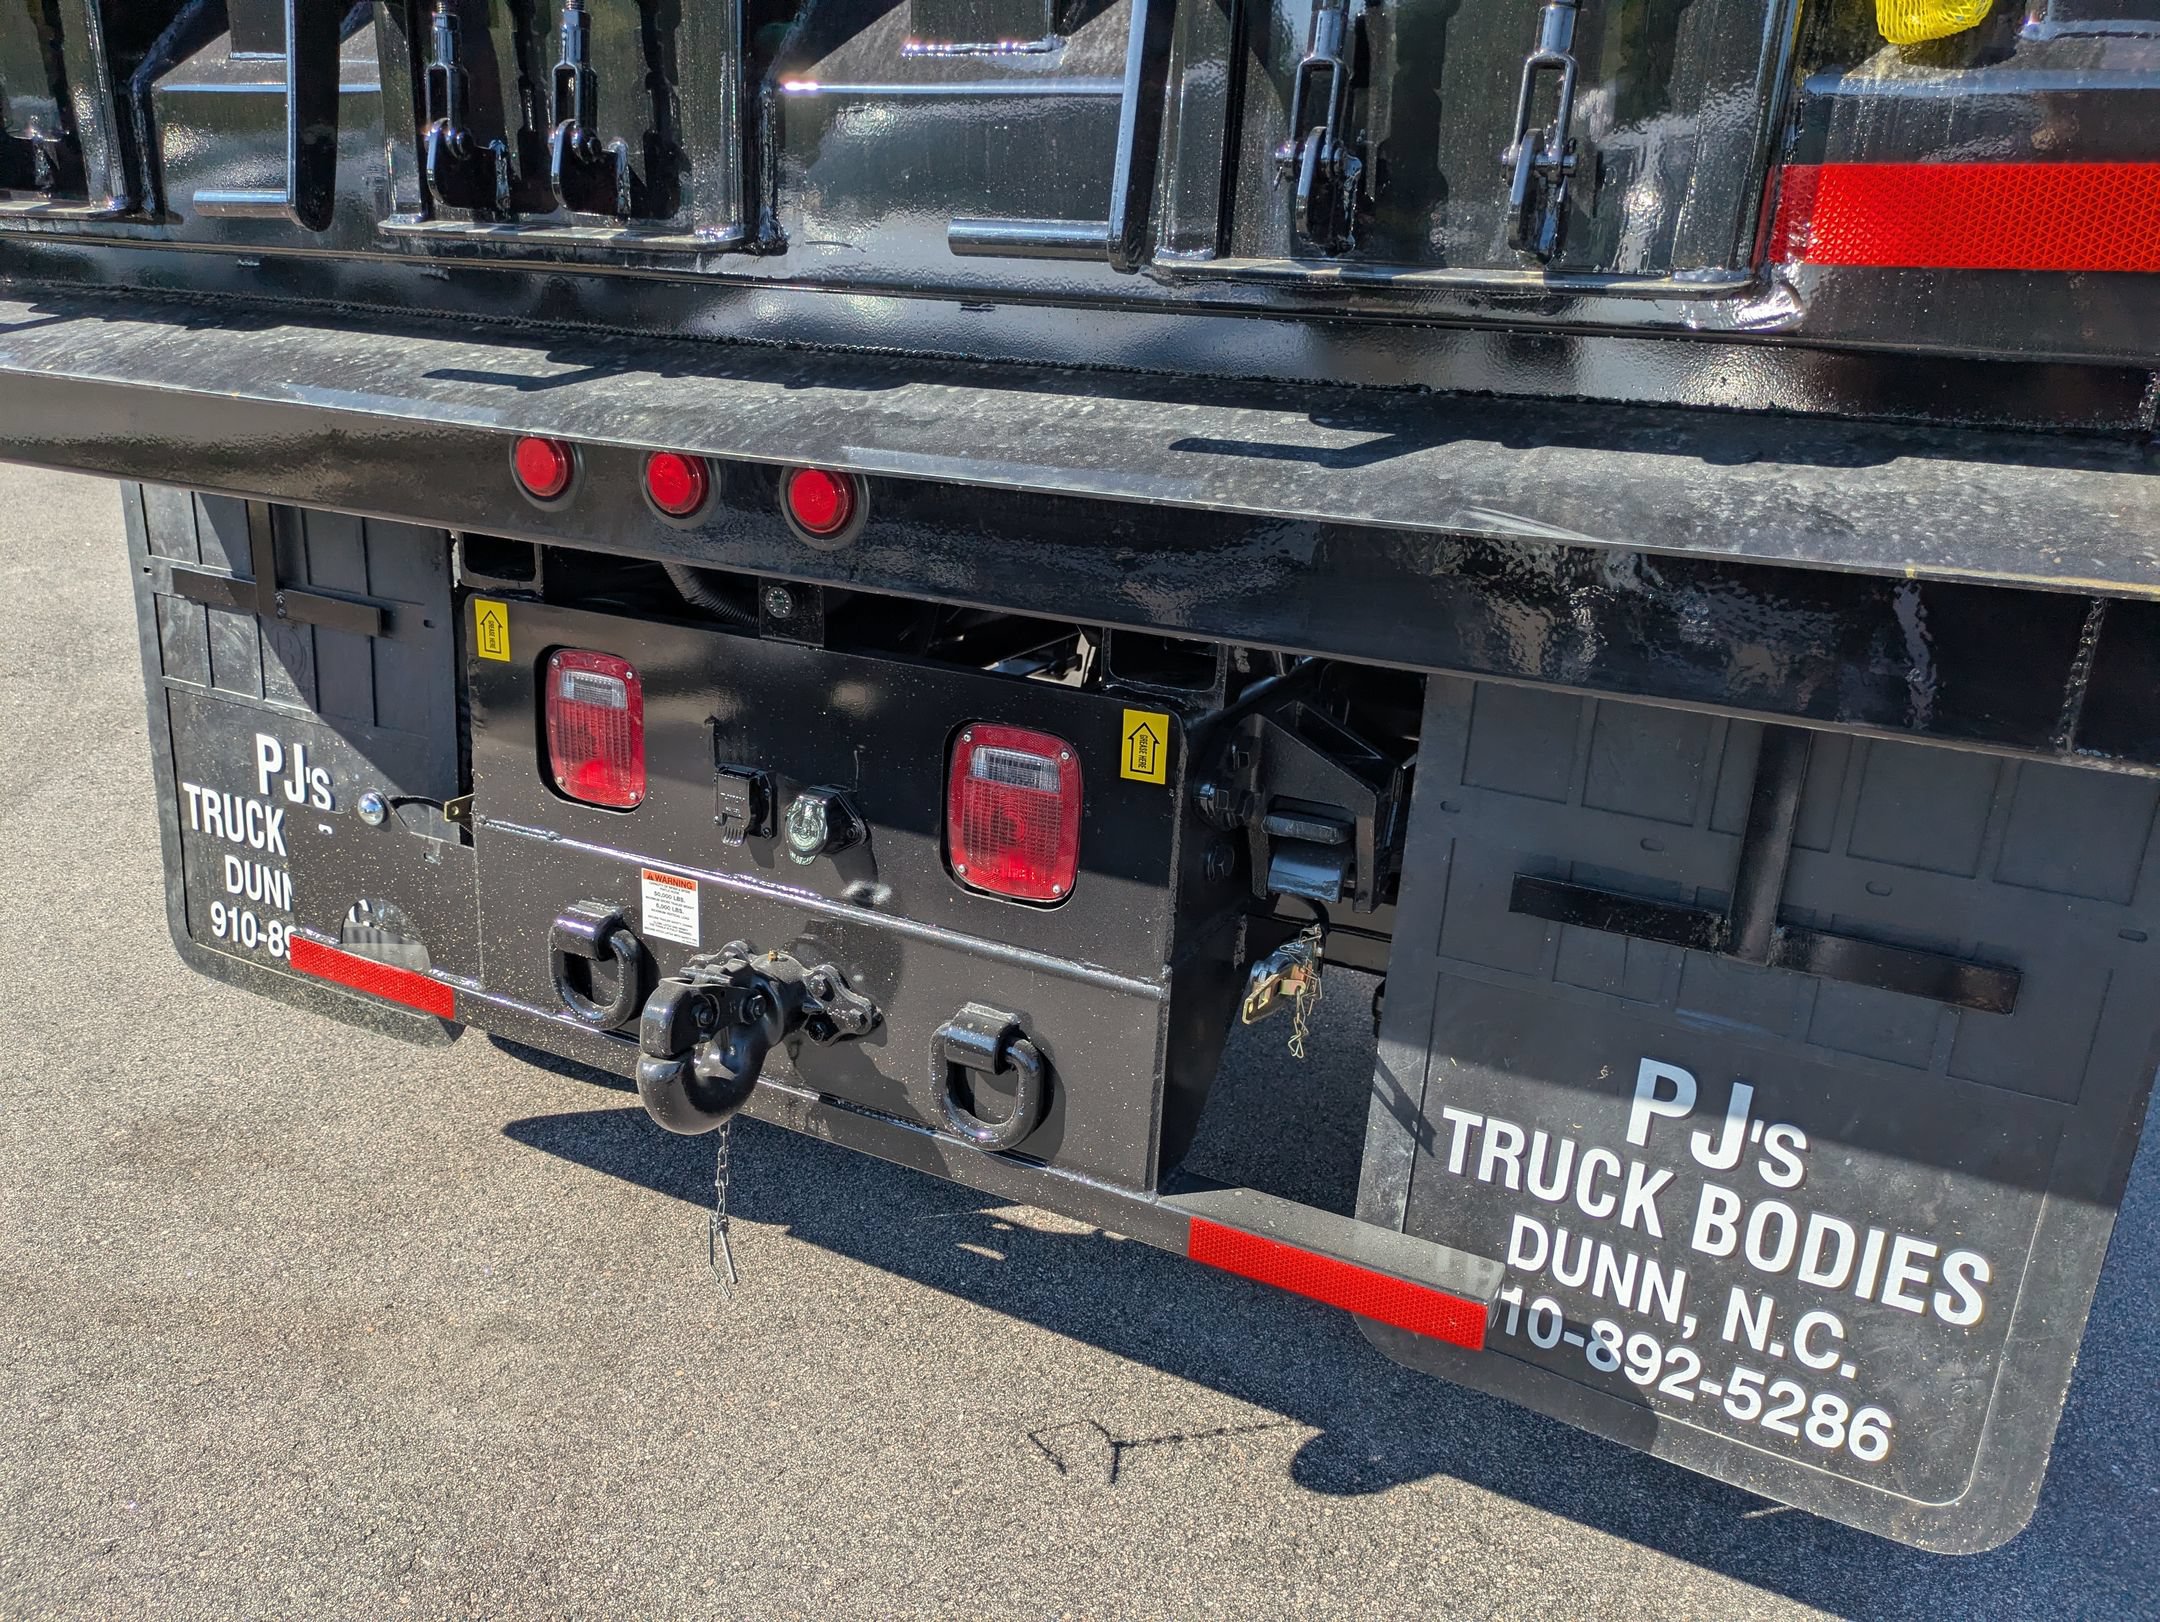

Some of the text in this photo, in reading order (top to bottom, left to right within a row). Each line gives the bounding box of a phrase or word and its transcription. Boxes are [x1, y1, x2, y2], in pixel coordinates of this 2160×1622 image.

[183, 782, 287, 857] TRUCK
[655, 873, 693, 890] WARNING
[1443, 1105, 1992, 1326] TRUCK BODIES
[1506, 1213, 1857, 1379] DUNN, N.C.
[1500, 1284, 1893, 1462] 10-892-5286
